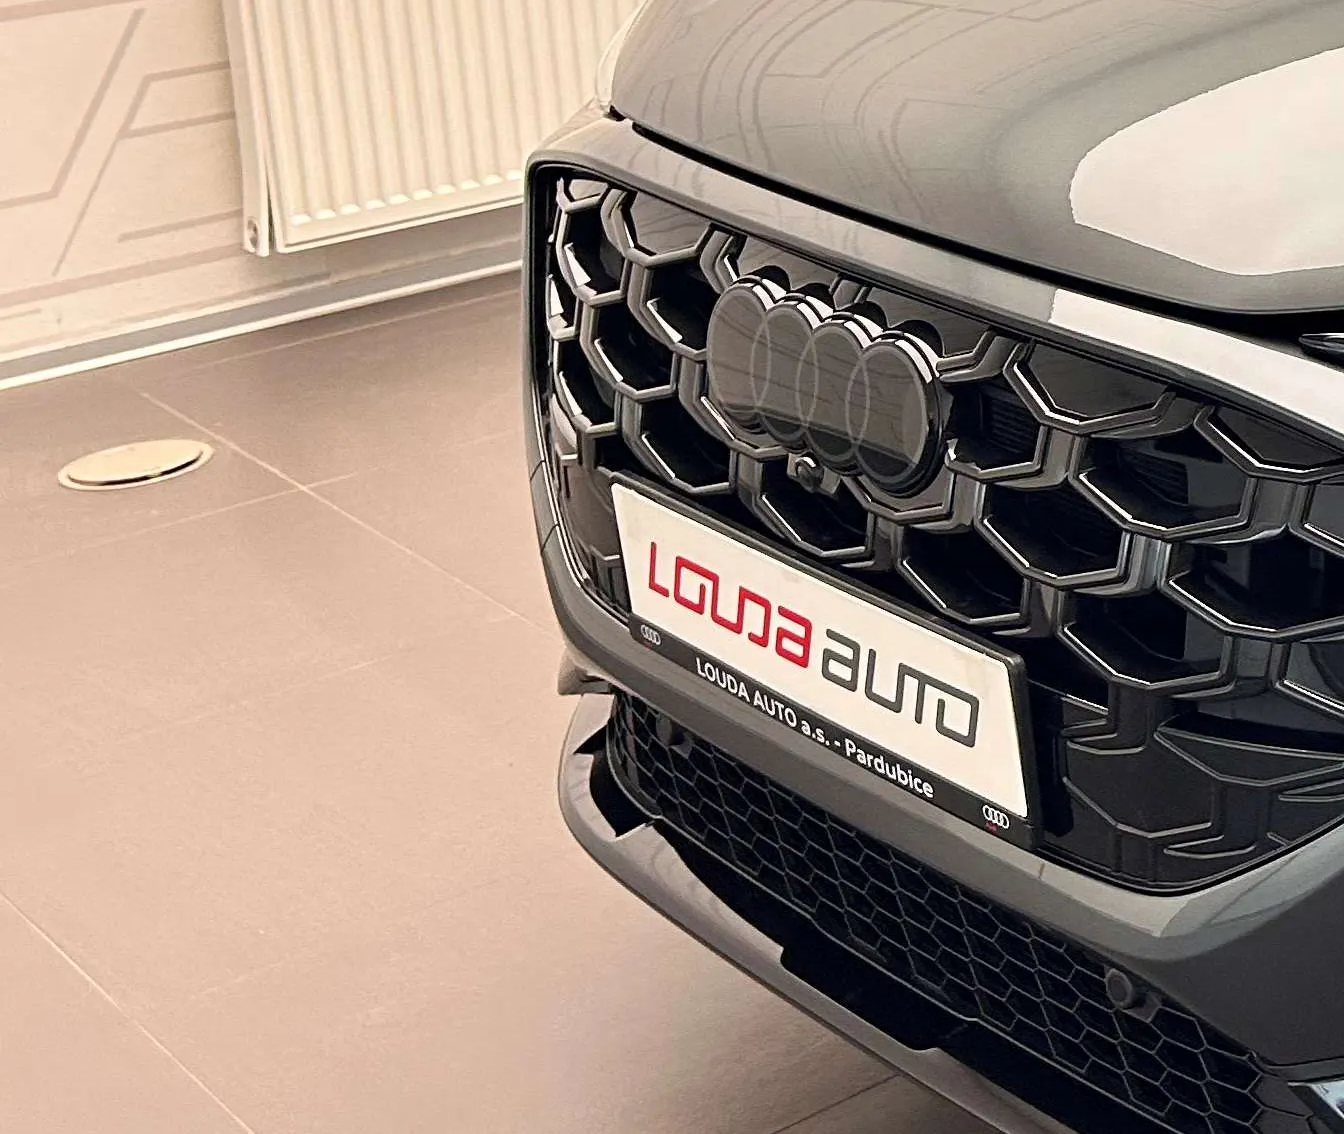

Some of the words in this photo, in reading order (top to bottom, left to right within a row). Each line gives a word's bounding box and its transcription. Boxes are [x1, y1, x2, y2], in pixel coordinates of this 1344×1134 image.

[695, 657, 751, 703] LOUDA
[753, 690, 797, 728] AUTO
[800, 719, 831, 747] a.s.
[844, 738, 935, 799] Pardubice
